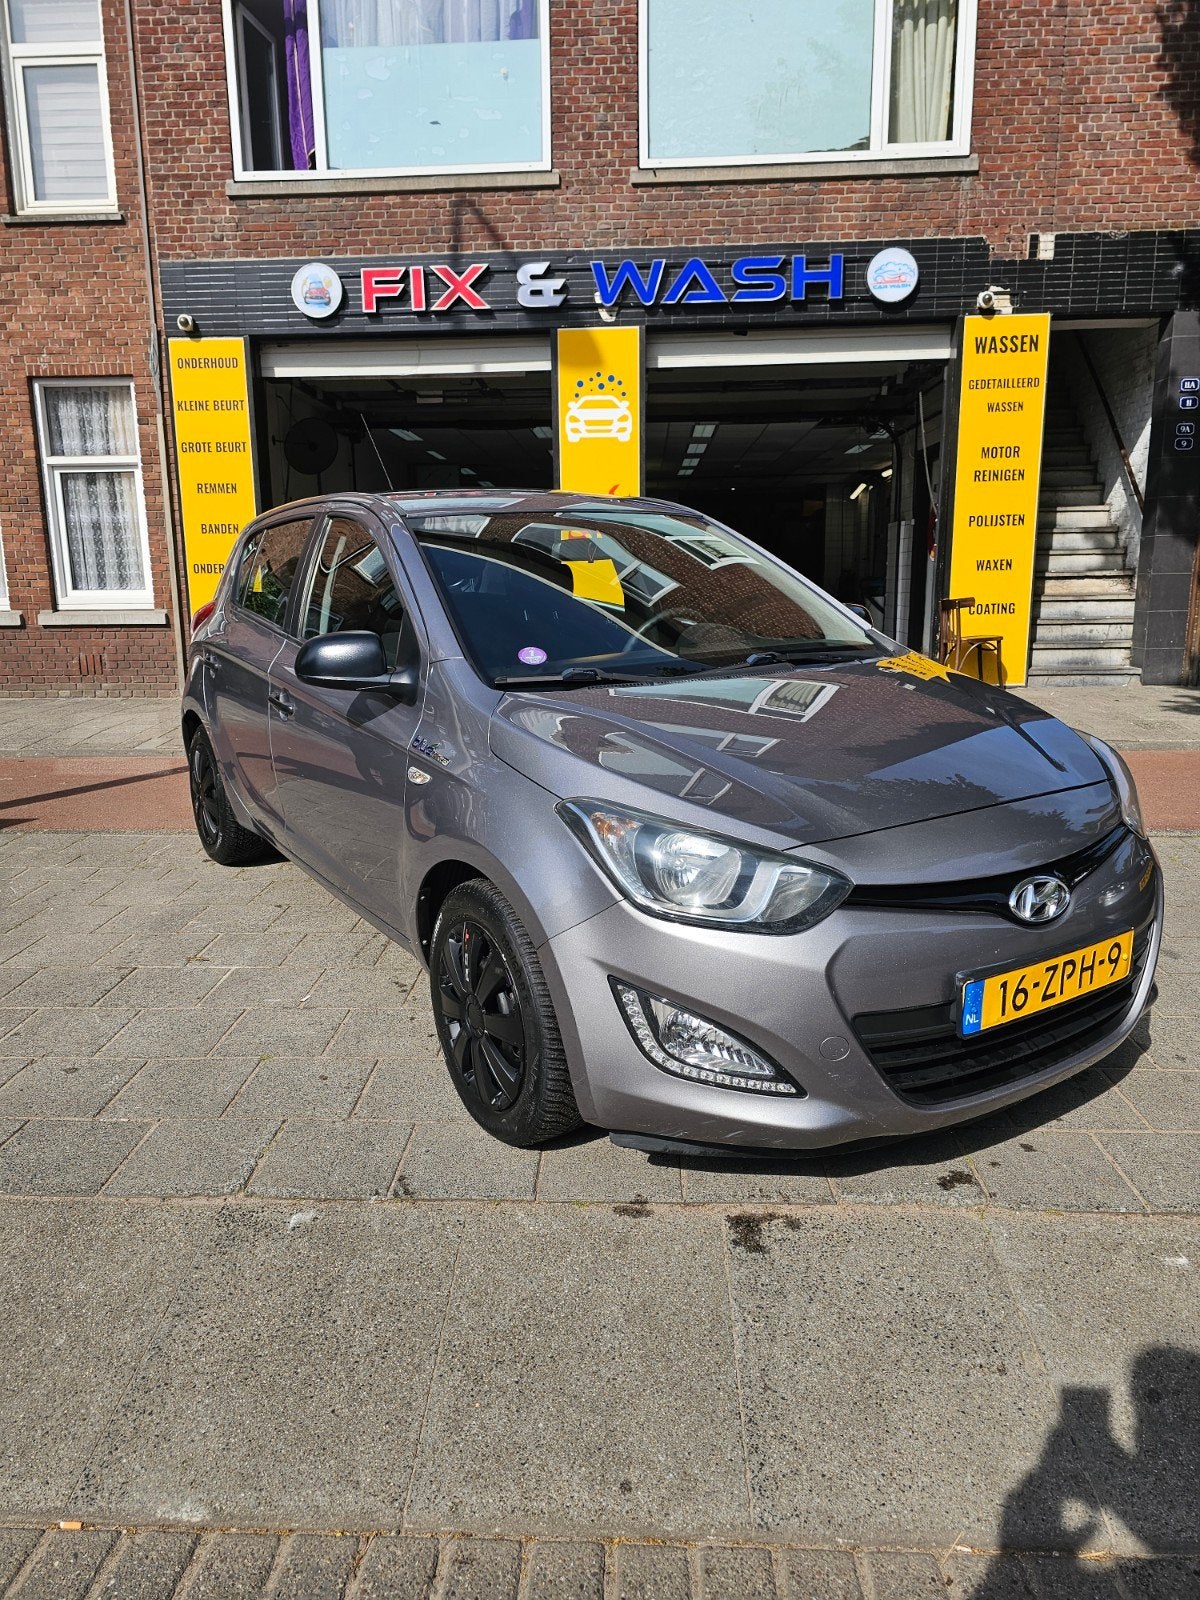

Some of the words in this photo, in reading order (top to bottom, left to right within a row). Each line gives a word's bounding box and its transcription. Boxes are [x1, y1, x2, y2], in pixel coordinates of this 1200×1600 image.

[361, 263, 491, 313] FIX
[516, 261, 567, 308] &
[590, 253, 844, 306] WASH
[975, 334, 1039, 354] WASSEN
[177, 357, 238, 369] ONDERHOUD
[968, 377, 1040, 390] GEDETAILLEERD
[177, 400, 209, 411] KLEINE
[213, 399, 244, 411] BEURT
[987, 401, 1024, 413] WASSEN
[1180, 425, 1191, 433] 9A
[181, 442, 212, 453] GROTE
[215, 441, 247, 453] BEURT
[981, 445, 1021, 459] MOTOR
[974, 469, 1025, 482] REINIGEN
[197, 483, 237, 494] REMMEN
[968, 514, 1025, 527] POLIJSTEN
[201, 523, 239, 534] BANDEN
[976, 559, 1013, 571] WAXEN
[968, 602, 1016, 615] COATING
[999, 941, 1122, 1017] 16-ZPH-9
[965, 1014, 979, 1026] NL
